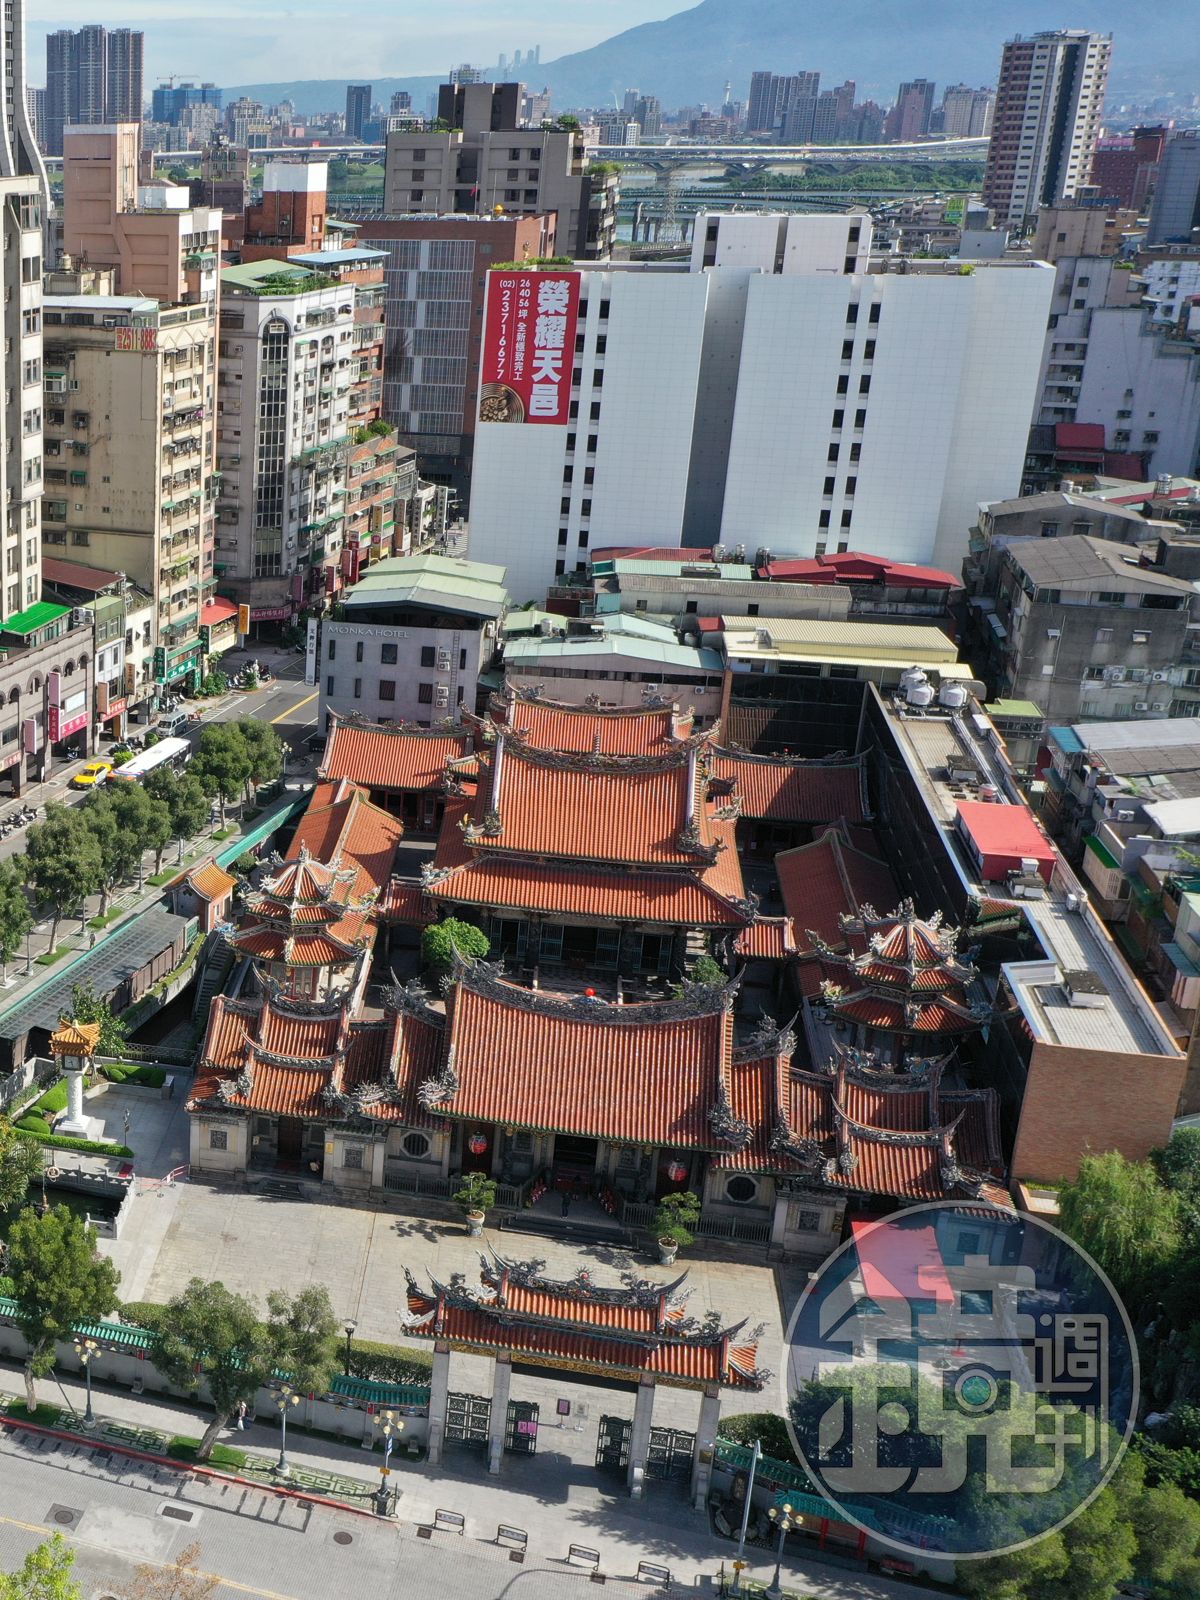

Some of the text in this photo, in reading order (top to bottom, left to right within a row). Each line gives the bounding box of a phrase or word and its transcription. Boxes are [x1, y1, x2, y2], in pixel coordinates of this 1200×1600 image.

[496, 279, 516, 380] (02) 23716677
[328, 626, 409, 638] MONKA HOTEL
